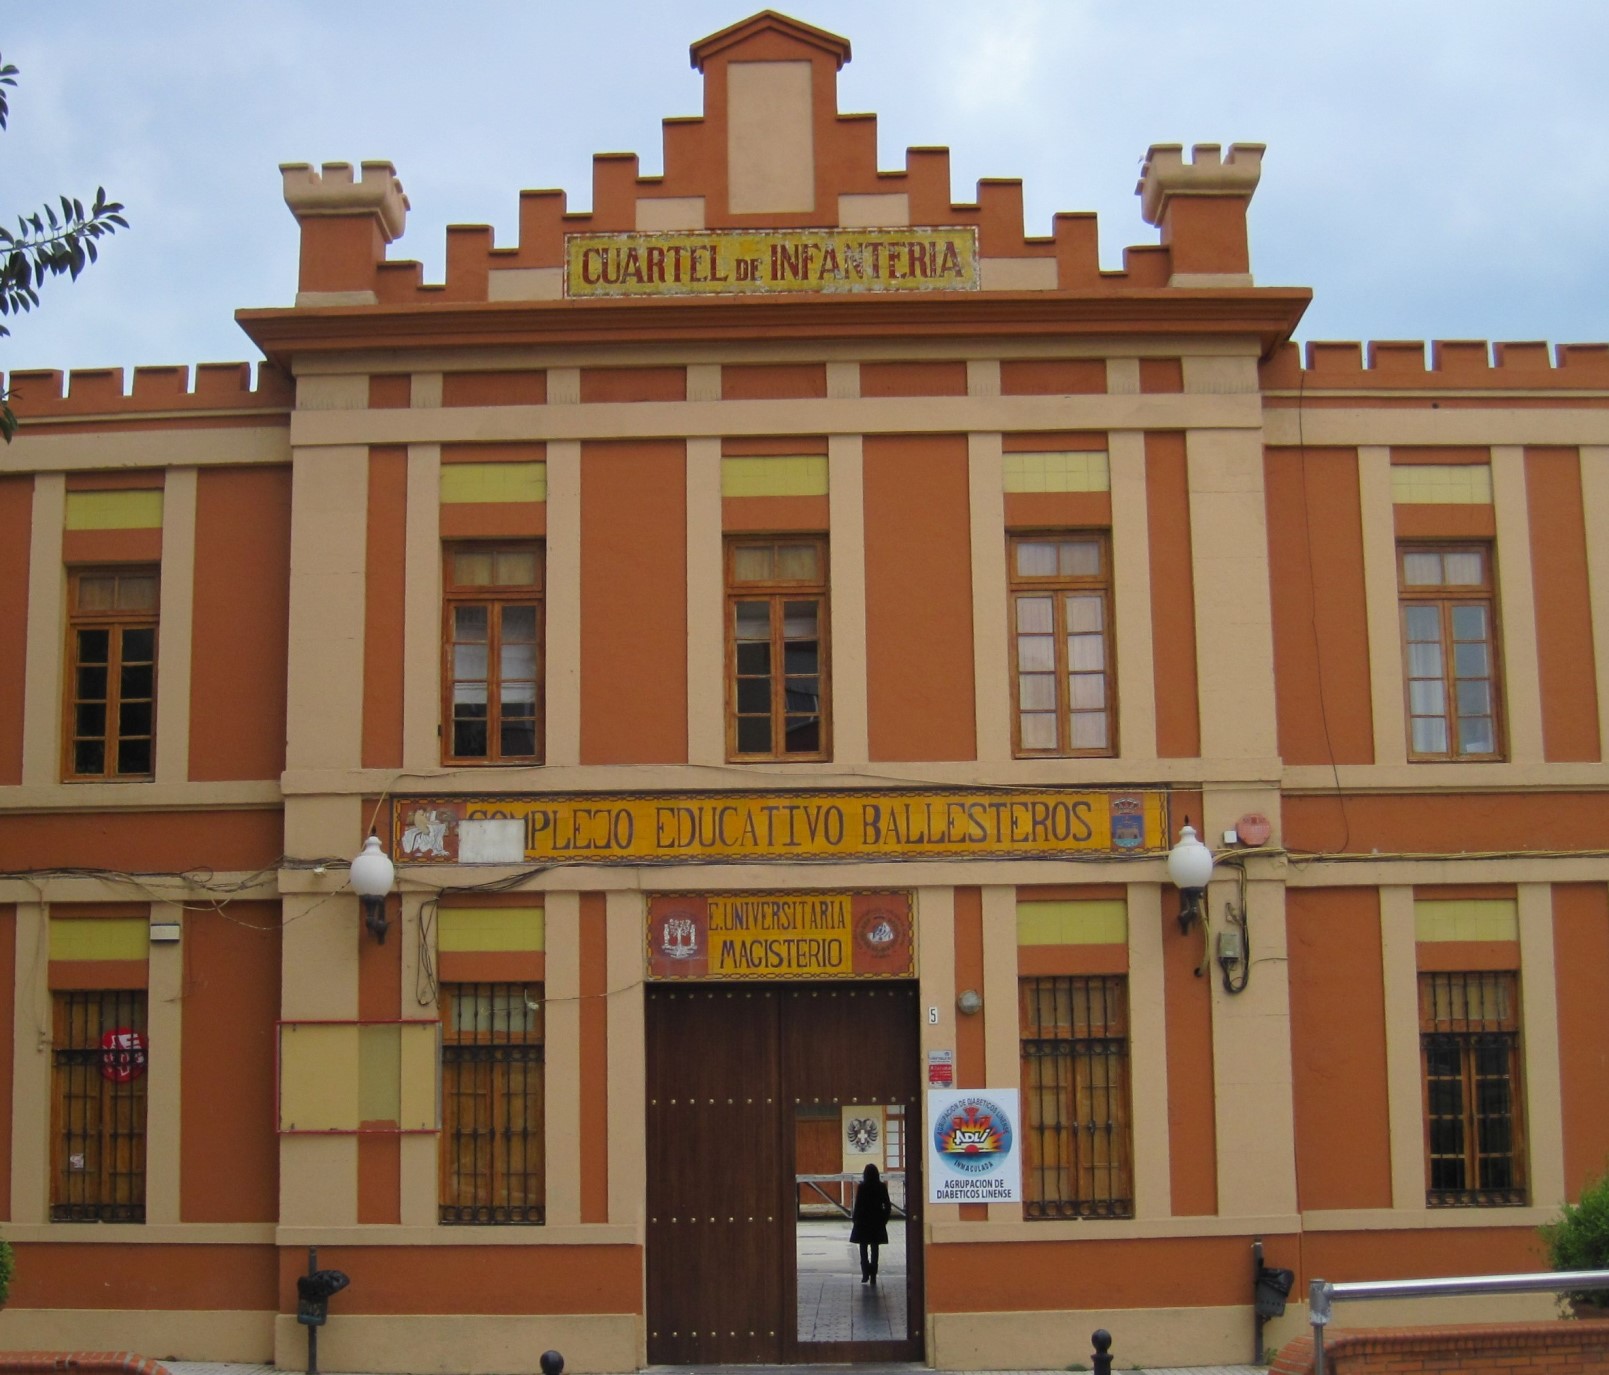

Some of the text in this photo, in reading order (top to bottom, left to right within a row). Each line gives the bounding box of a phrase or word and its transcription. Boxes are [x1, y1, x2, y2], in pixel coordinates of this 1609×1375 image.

[582, 240, 963, 285] CUARTEL DE INFANTERIA
[468, 800, 1092, 850] PLEJO EDUCATIVO BALLESTEROS
[720, 938, 842, 969] MAGISTERIO
[930, 1008, 936, 1022] 5
[959, 1099, 967, 1107] DE
[953, 1160, 993, 1172] INMACULADA
[944, 1179, 1004, 1189] AGRUPACION DE
[936, 1189, 1012, 1199] DIABETICOS LINENSE
